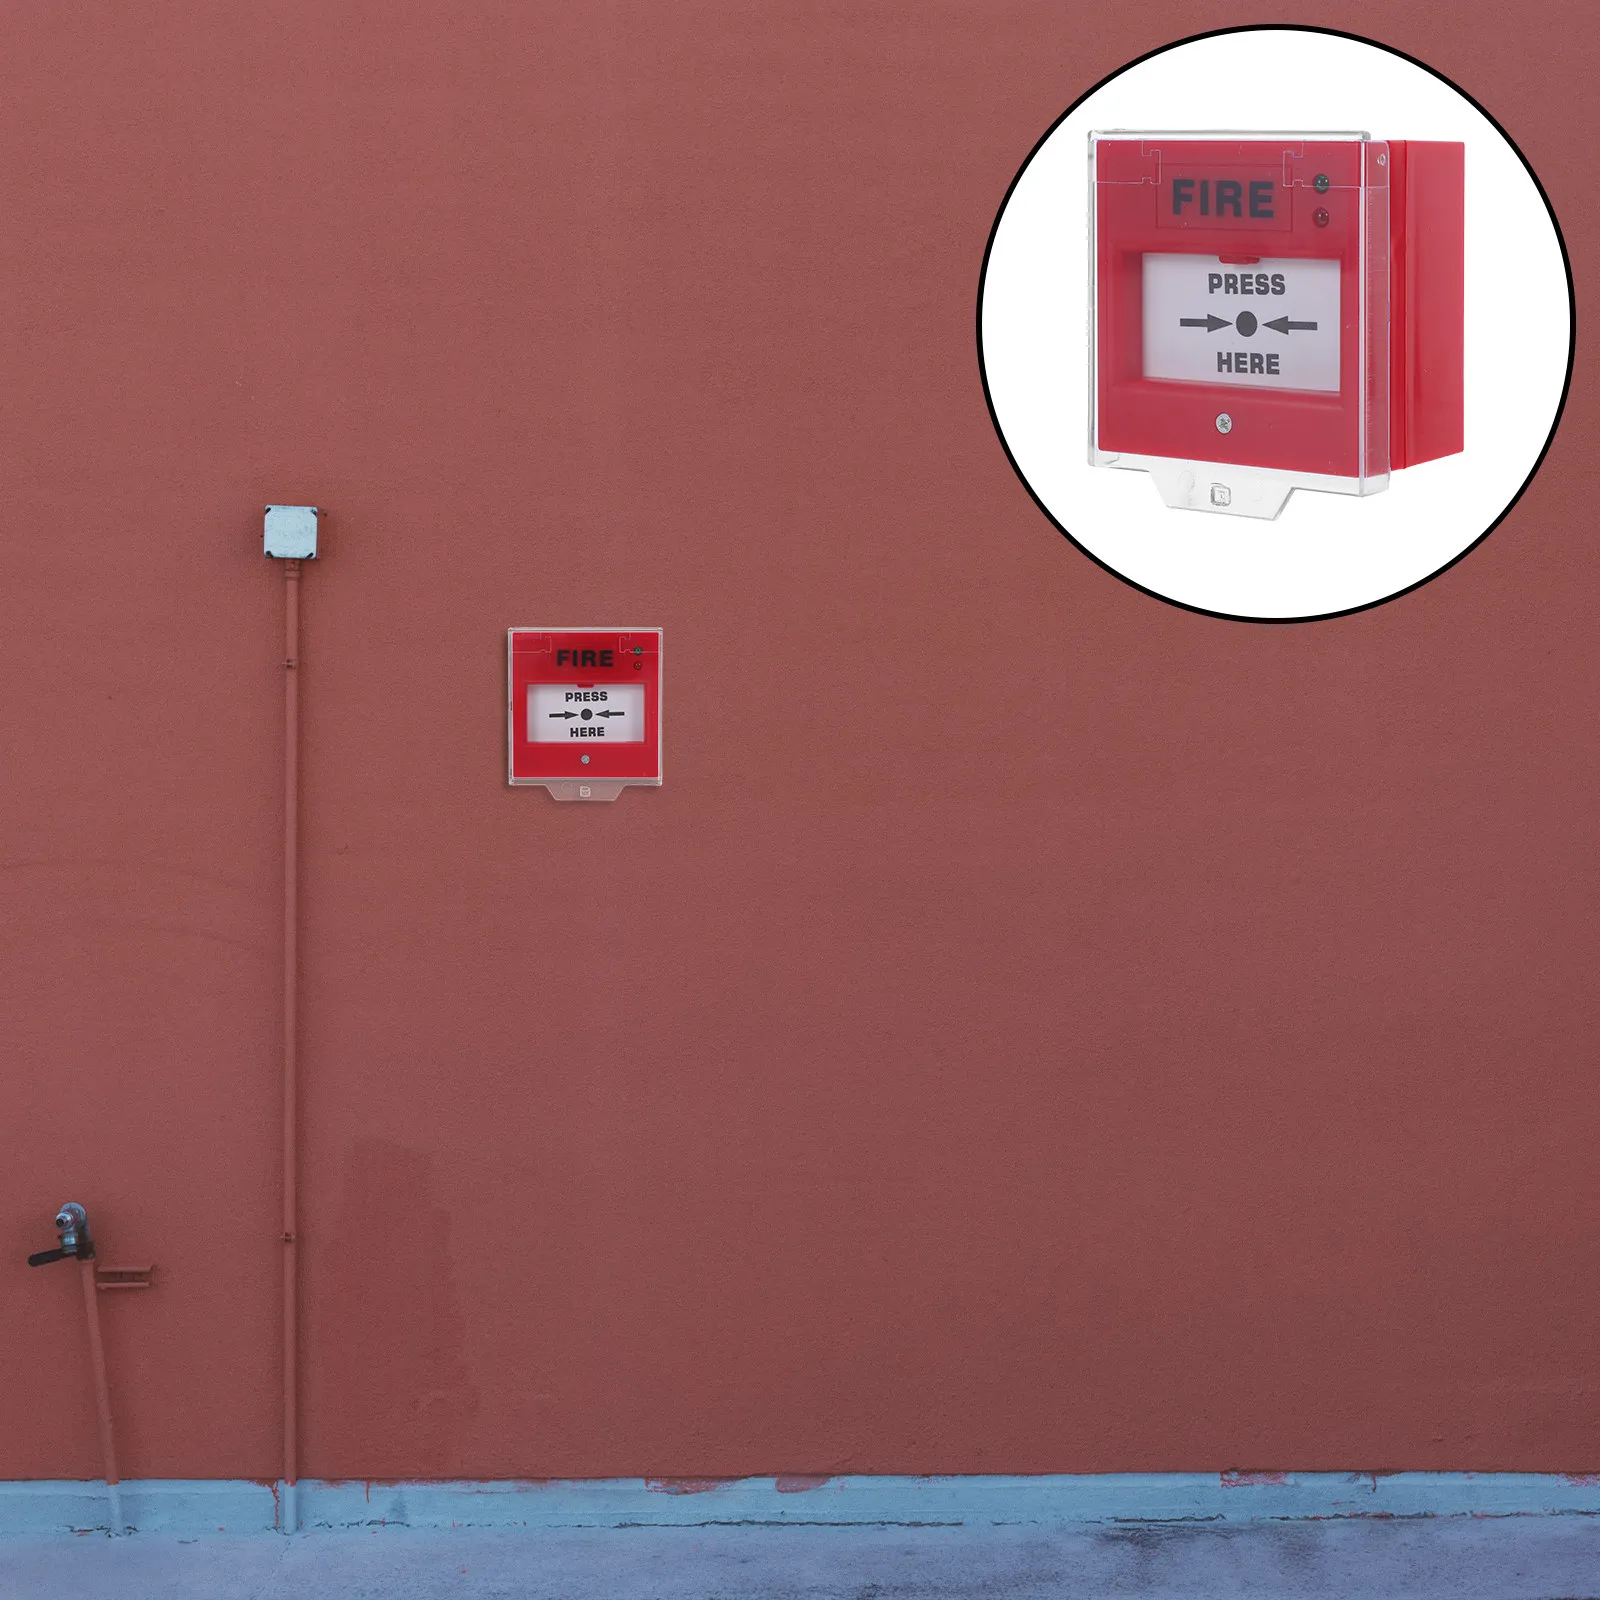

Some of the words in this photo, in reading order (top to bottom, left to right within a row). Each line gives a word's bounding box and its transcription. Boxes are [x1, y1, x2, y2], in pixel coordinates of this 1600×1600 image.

[1172, 178, 1274, 219] FIRE
[1208, 273, 1286, 296] PRESS
[1216, 351, 1280, 375] HERE
[557, 650, 613, 666] FIRE
[565, 691, 608, 702] PRESS
[569, 727, 605, 737] HERE
